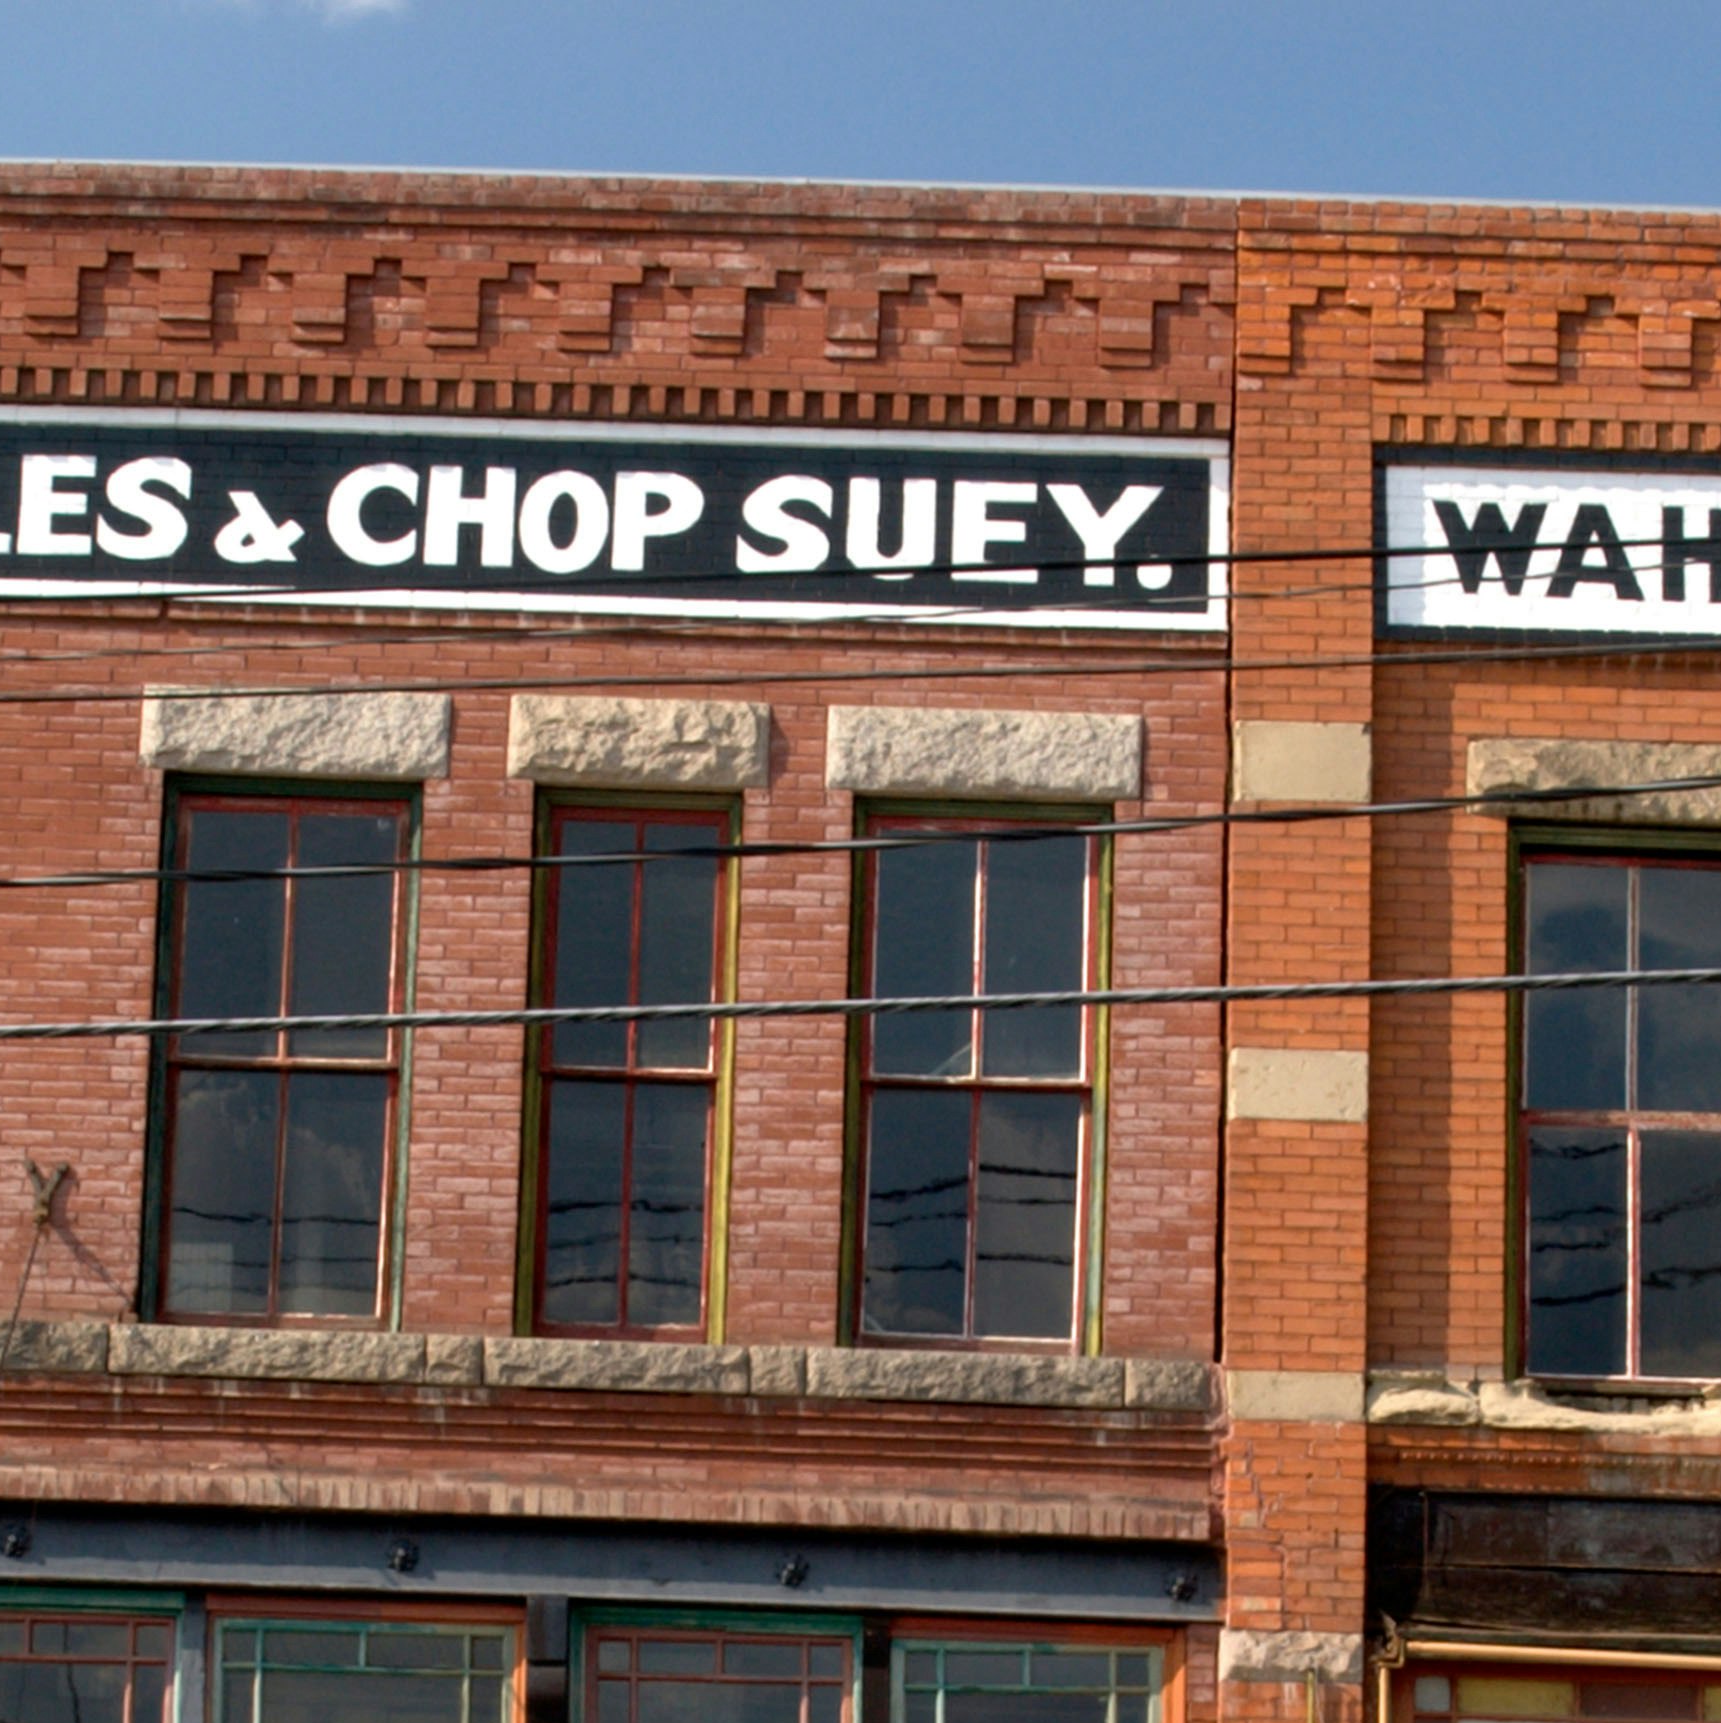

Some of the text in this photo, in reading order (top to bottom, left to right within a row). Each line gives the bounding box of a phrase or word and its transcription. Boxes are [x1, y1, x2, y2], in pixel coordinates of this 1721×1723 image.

[213, 488, 306, 564] &
[325, 461, 704, 573] CHOP
[734, 474, 1173, 590] SUEY.
